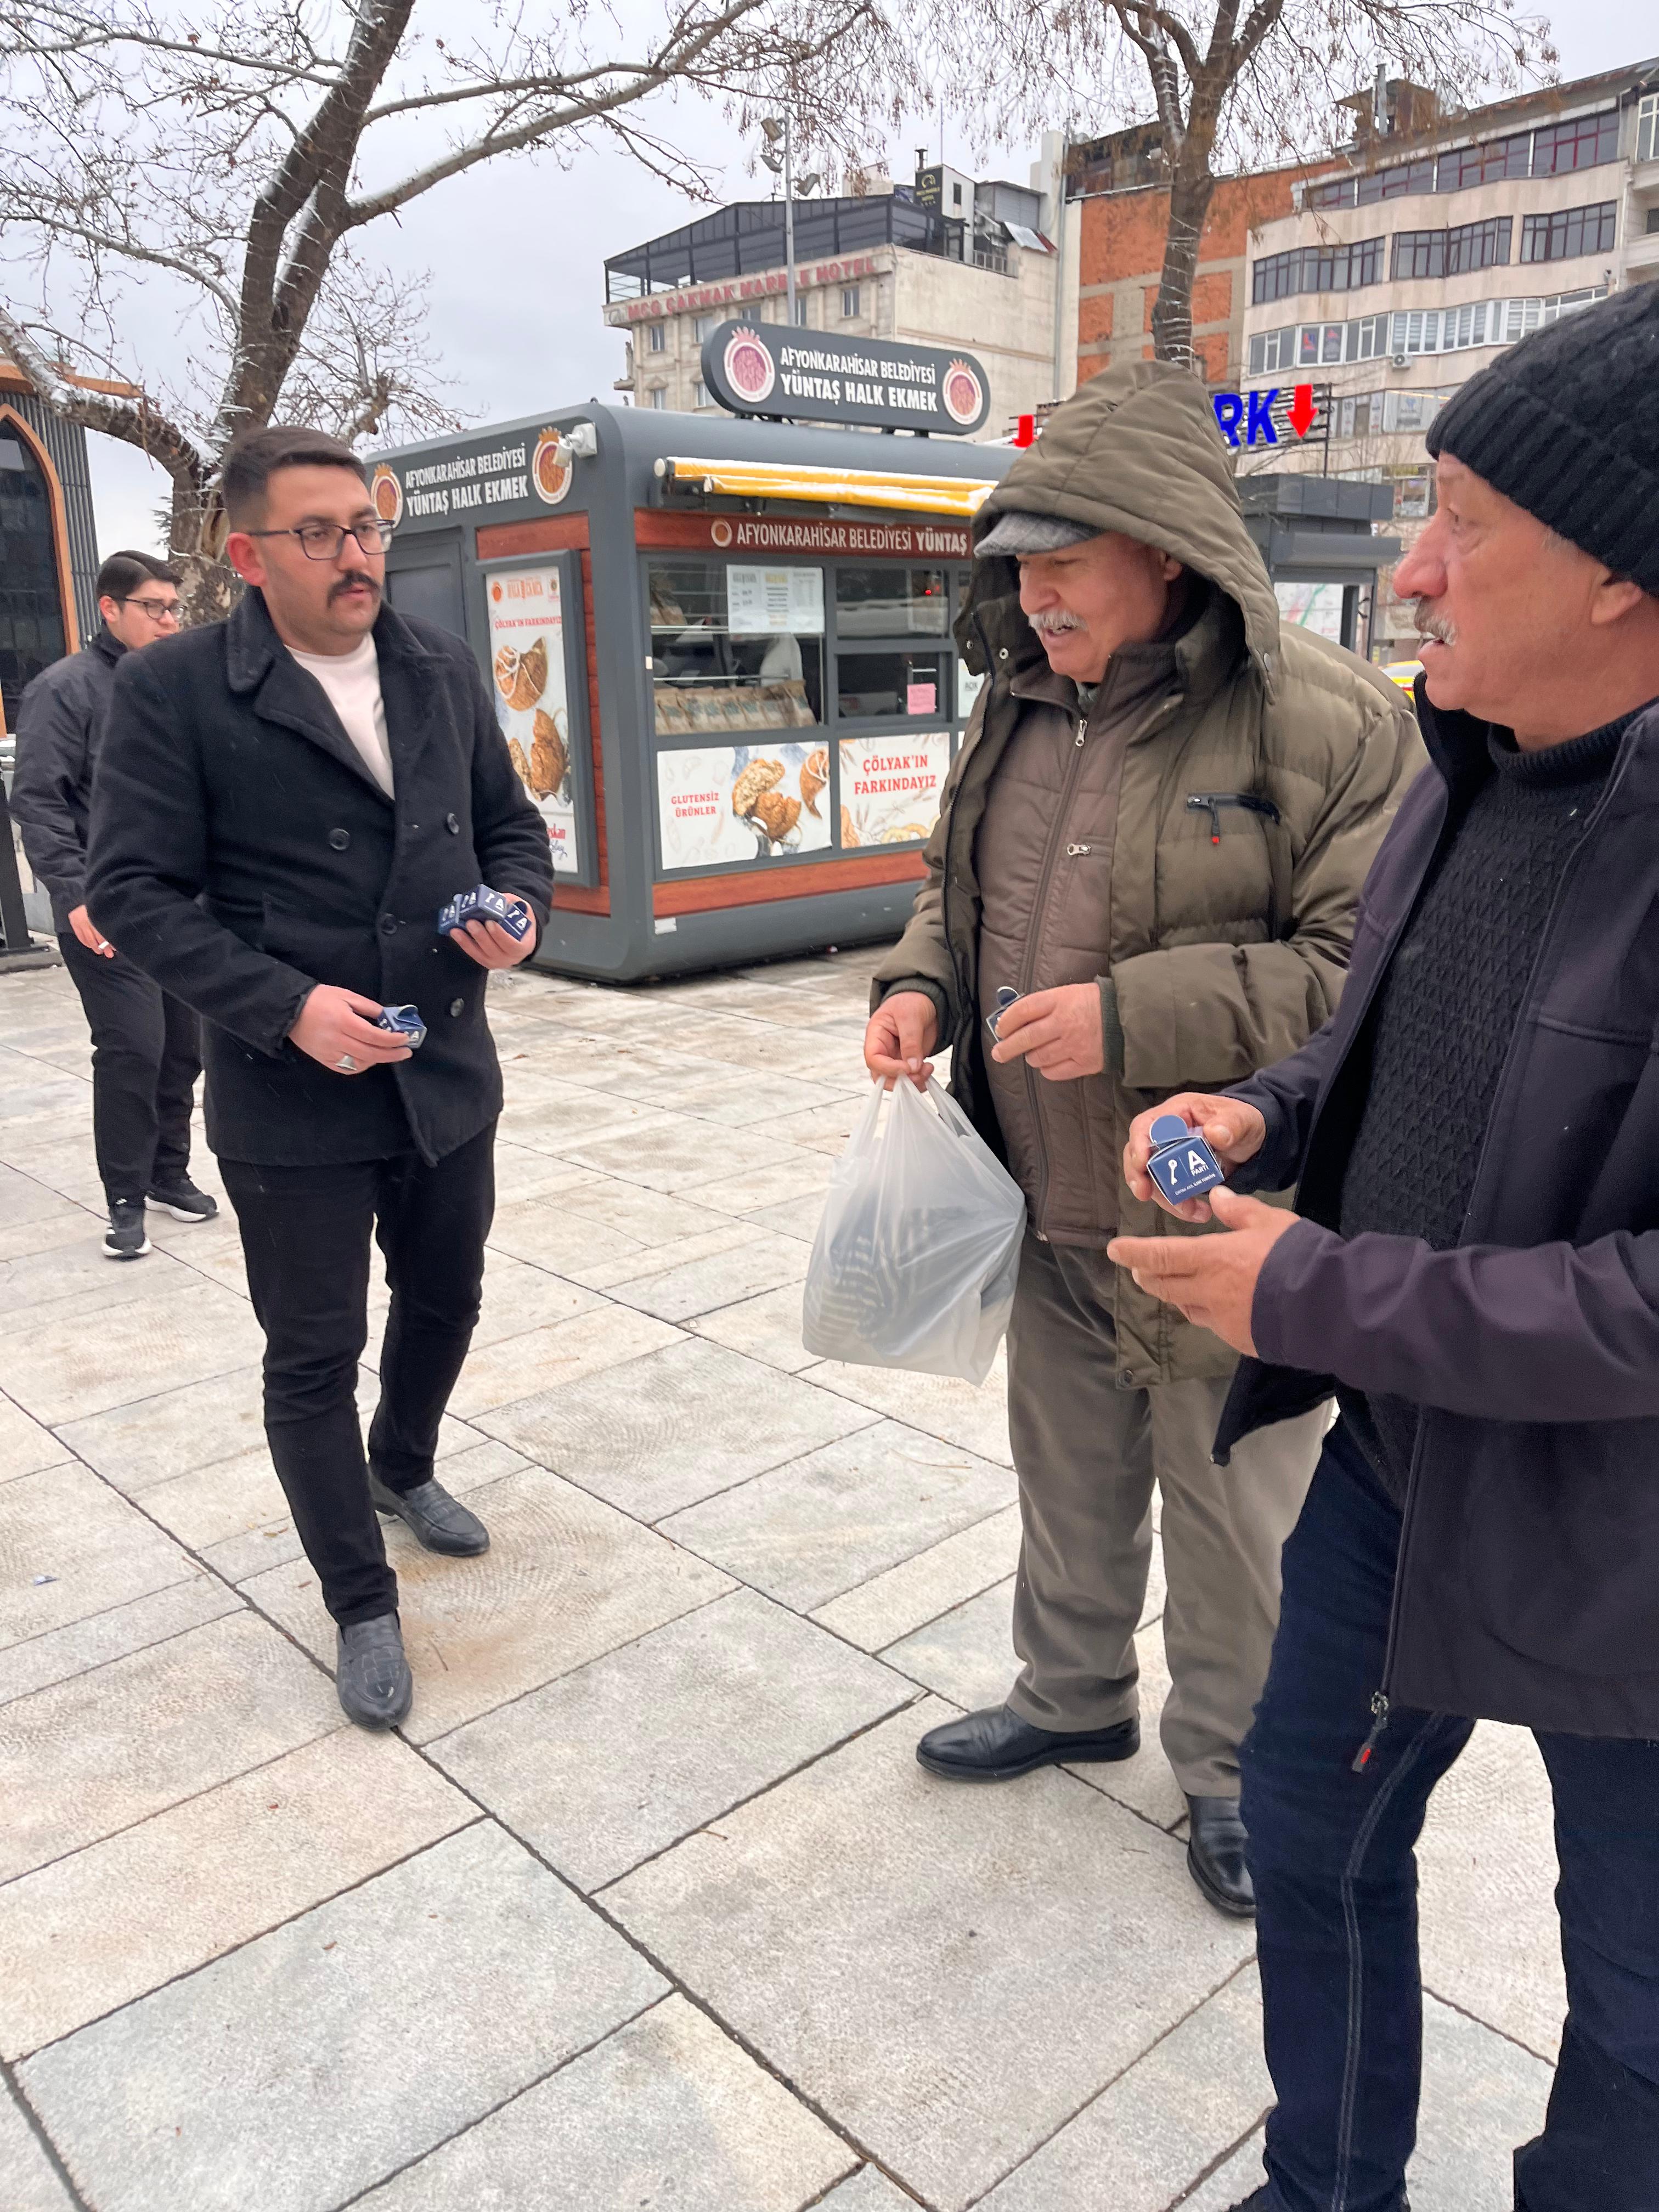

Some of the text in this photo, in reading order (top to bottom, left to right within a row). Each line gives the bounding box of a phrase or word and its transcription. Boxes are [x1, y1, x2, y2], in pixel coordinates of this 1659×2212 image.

[666, 284, 734, 317] ÇAKMAK
[740, 268, 810, 298] MARBE
[816, 256, 876, 281] HOTEL
[780, 346, 935, 385] AFYONKARAHİSAR BELEDİYESİ
[780, 368, 938, 412] YÜNTAŞ HALK EKMEK
[405, 442, 526, 489] AFYONKARAHİSAR BELEDİYESİ
[406, 475, 529, 517] YÜNTAŞ HALK EKMEK
[737, 522, 968, 556] AFYONKARAHİSAR BELEDİYESİ YÜNTAŞ
[863, 754, 928, 776] ÇÖLYAK'IN
[671, 790, 719, 804] GLUTENSİZ
[854, 775, 936, 795] FARKINDAYIZ
[675, 805, 716, 817] ÜRÜNLER
[1188, 1150, 1206, 1171] A
